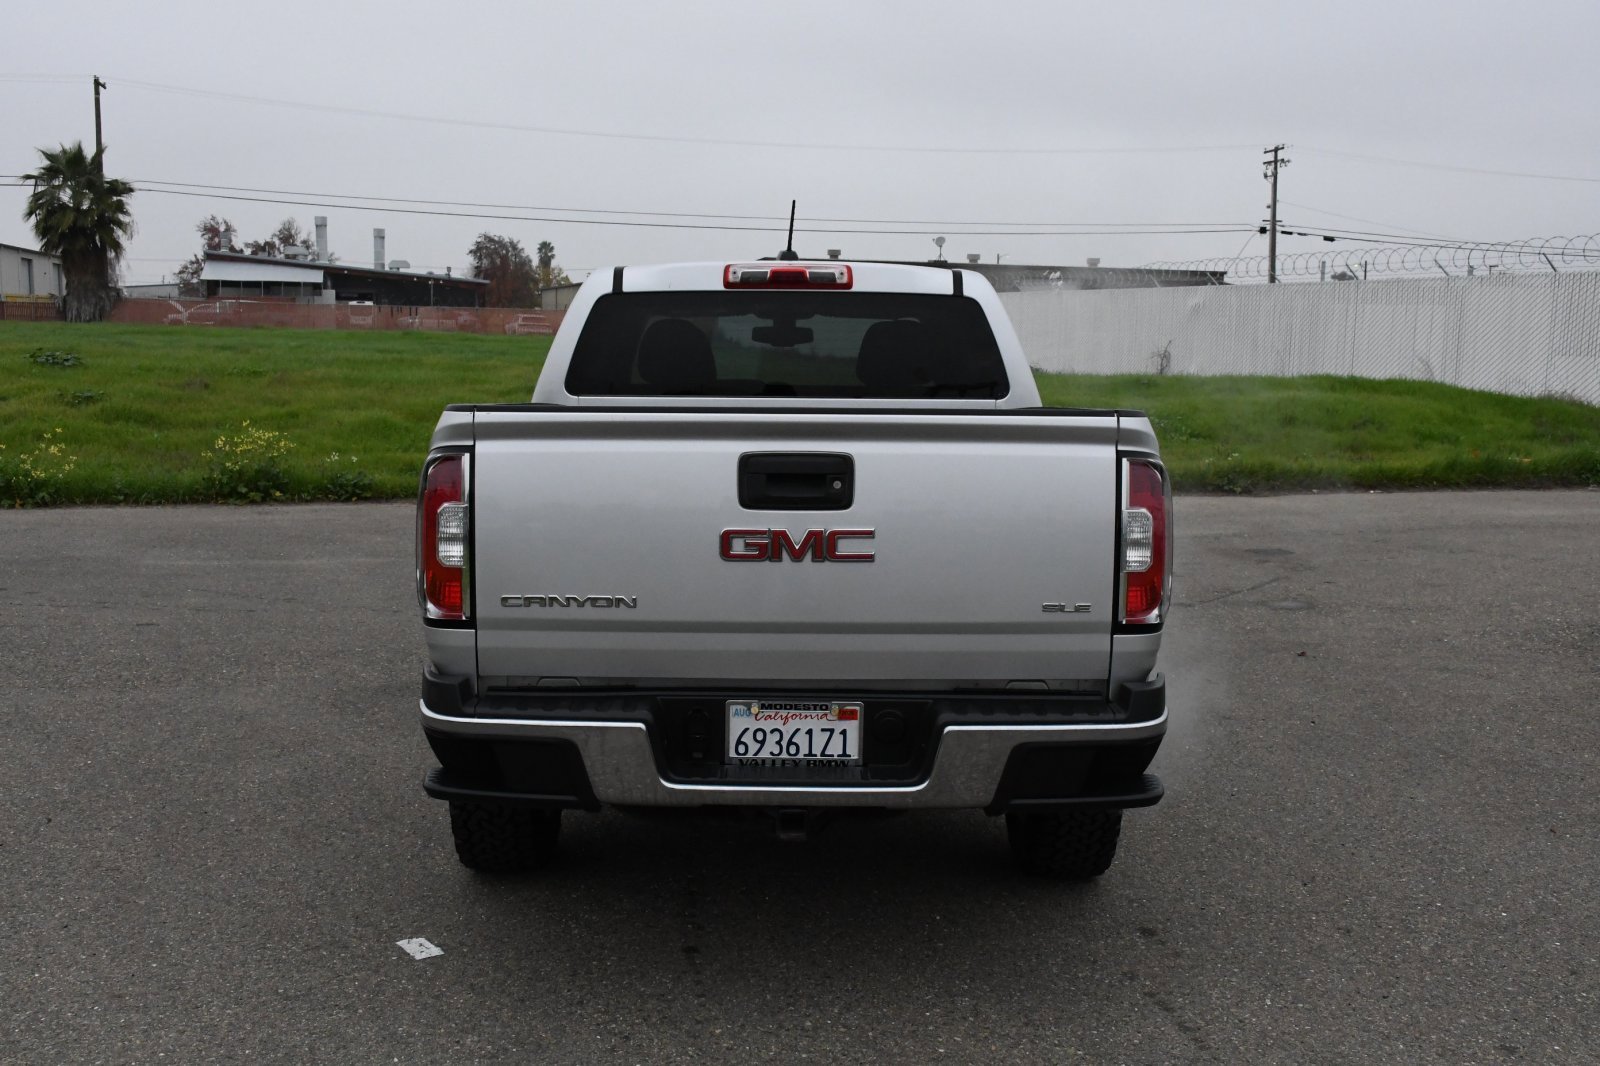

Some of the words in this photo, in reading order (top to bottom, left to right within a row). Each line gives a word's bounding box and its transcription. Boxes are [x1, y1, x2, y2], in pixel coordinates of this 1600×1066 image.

[719, 528, 875, 562] GMC
[500, 594, 637, 608] CANYON
[1041, 602, 1092, 613] SLE
[733, 708, 751, 717] AUG
[760, 703, 829, 711] MODESTO
[754, 711, 836, 726] California
[734, 727, 852, 758] 69361Z1
[738, 759, 802, 768] VALLEY
[806, 759, 850, 768] BMW
